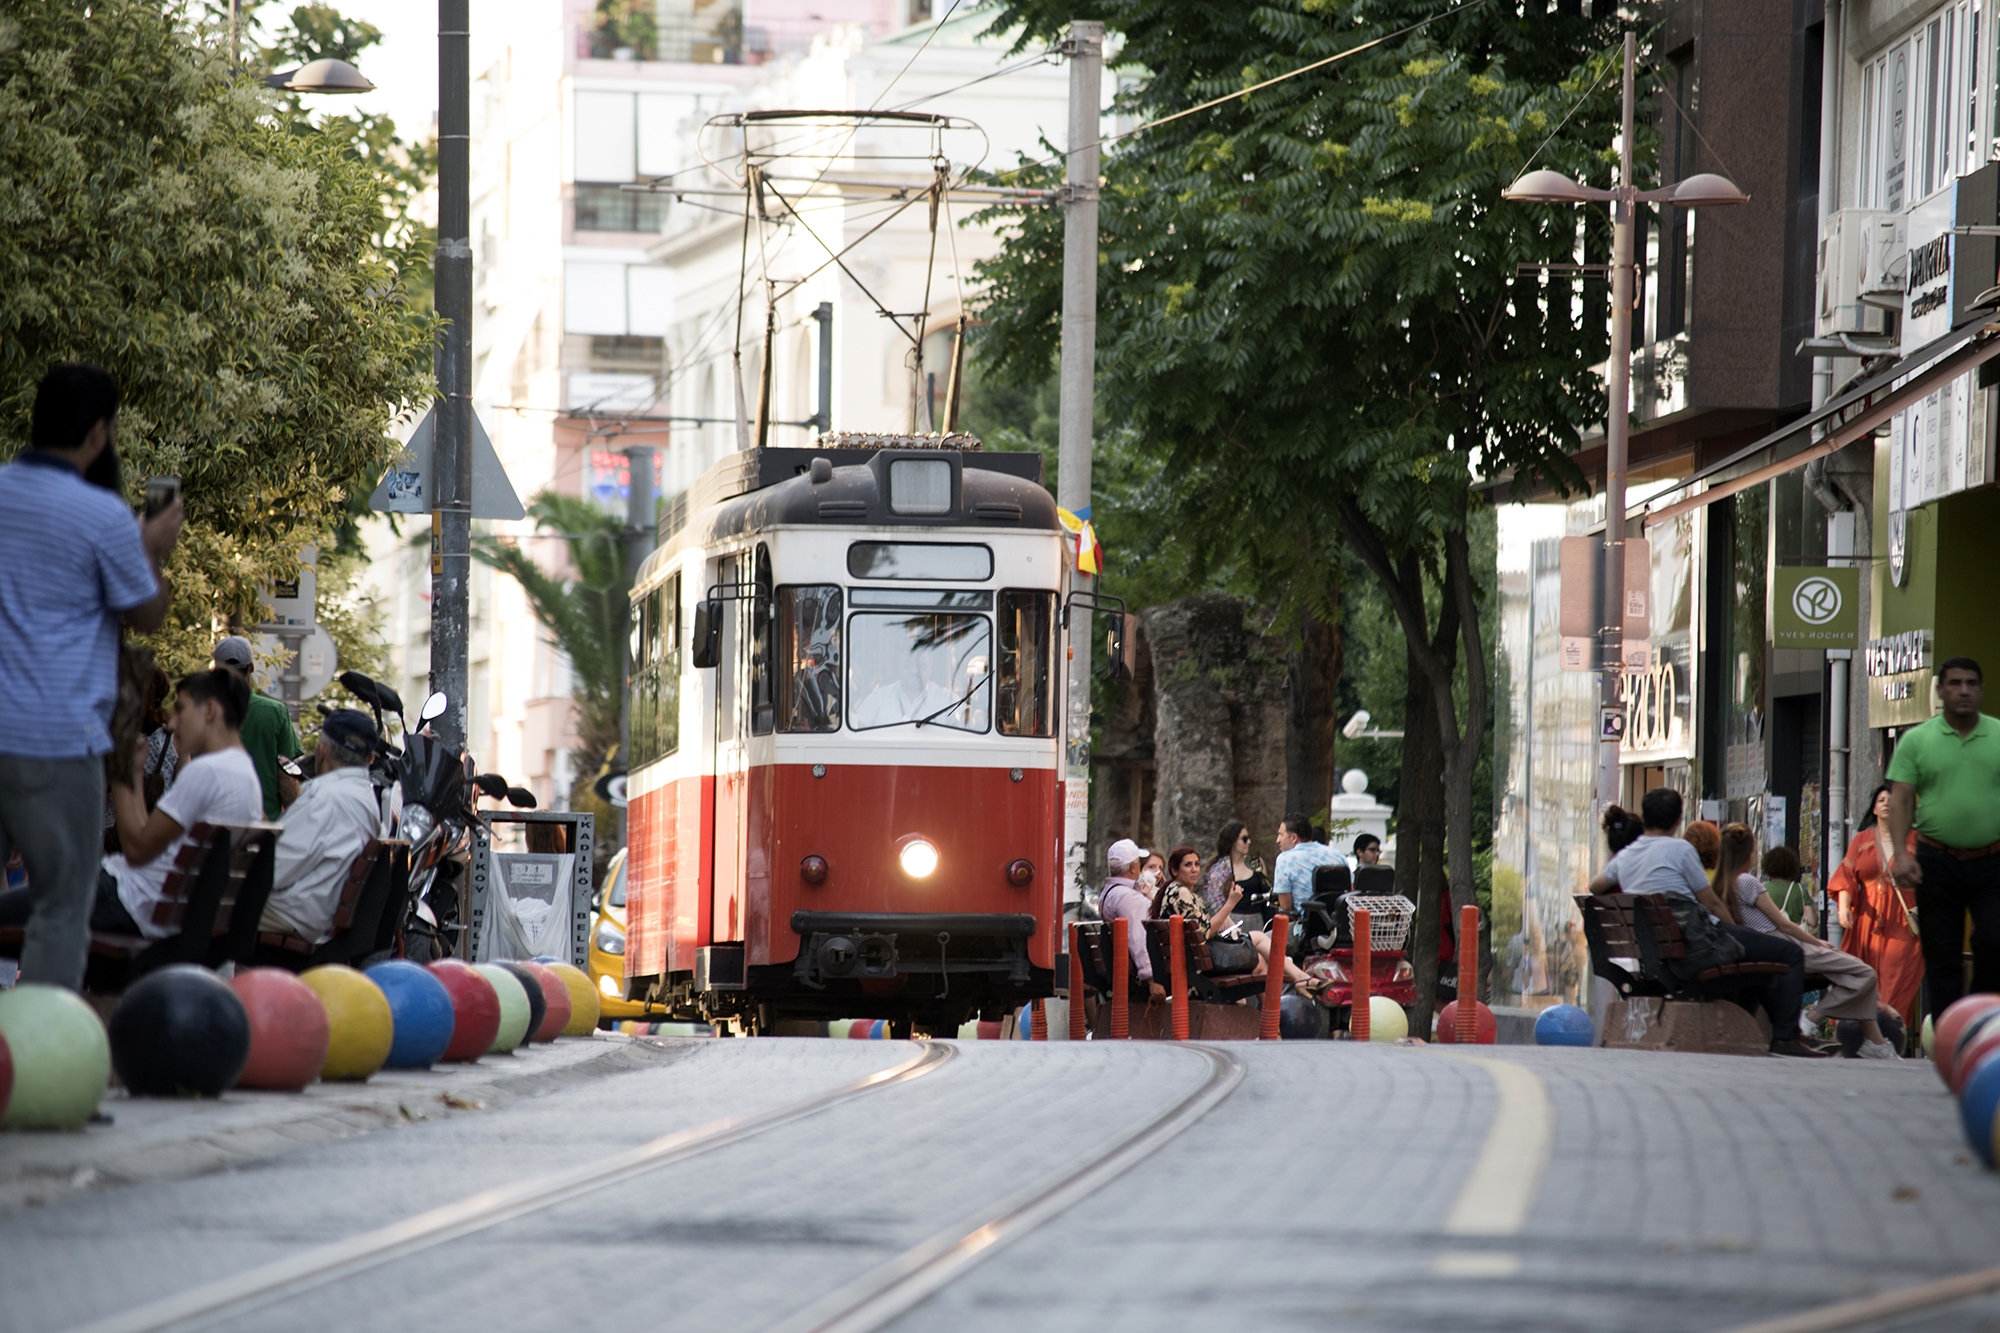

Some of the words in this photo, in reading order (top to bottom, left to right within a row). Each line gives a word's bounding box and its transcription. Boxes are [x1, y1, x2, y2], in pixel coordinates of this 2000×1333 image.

[1779, 631, 1805, 639] YVES
[1809, 631, 1854, 639] ROCHER
[1887, 629, 1924, 675] ROCHER
[1619, 648, 1676, 752] eFacto
[474, 840, 487, 893] DIKÖY
